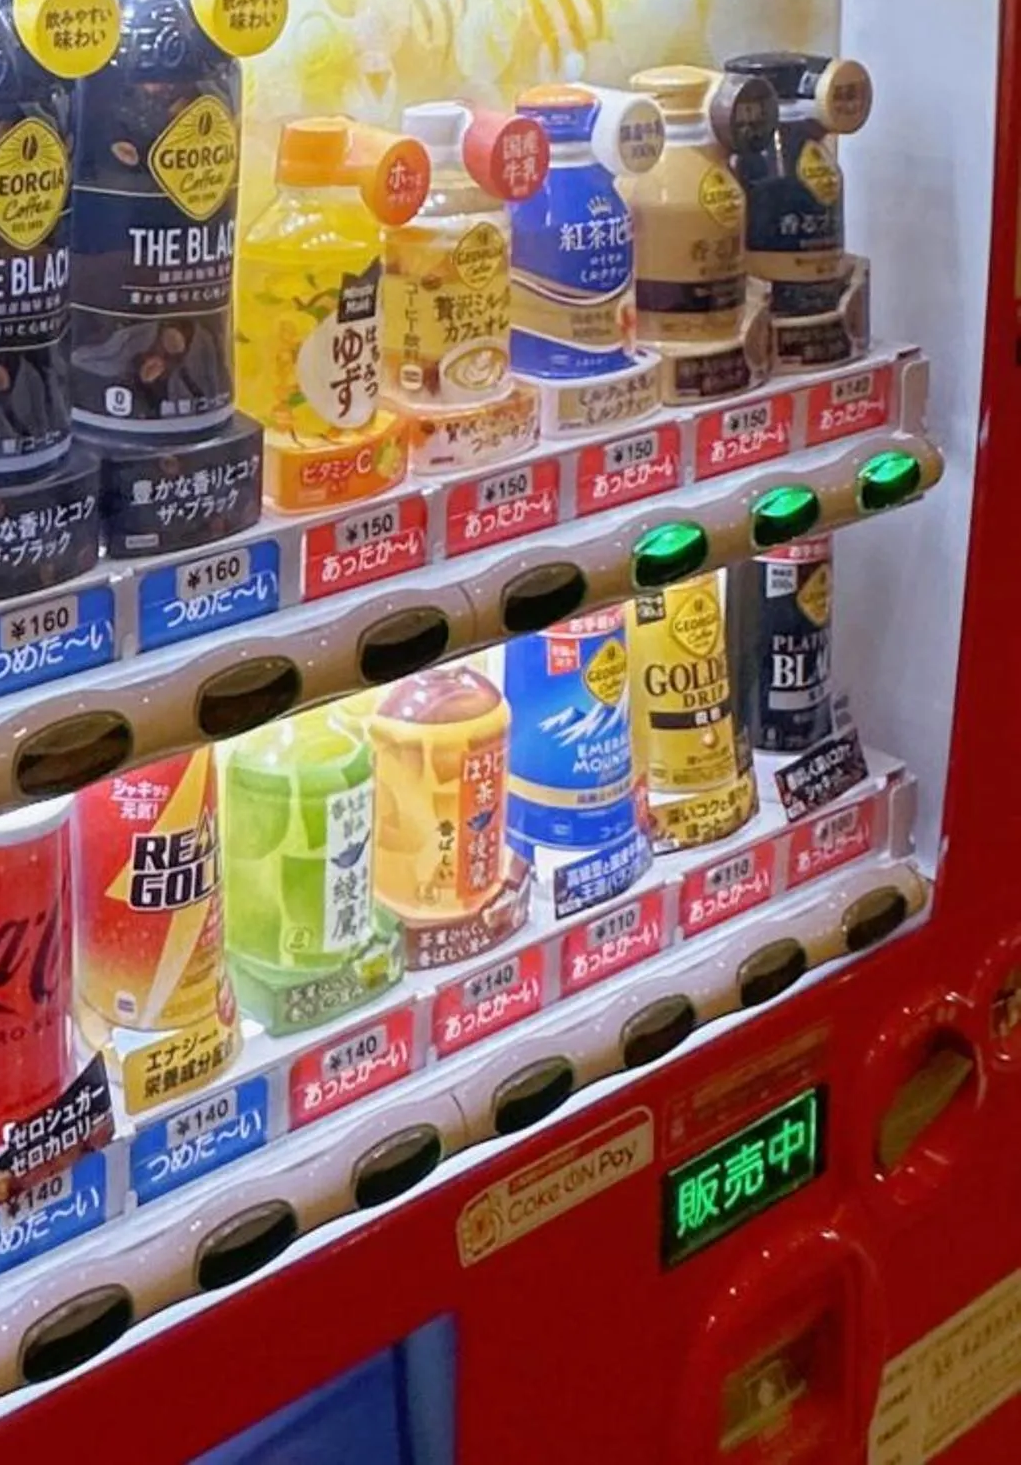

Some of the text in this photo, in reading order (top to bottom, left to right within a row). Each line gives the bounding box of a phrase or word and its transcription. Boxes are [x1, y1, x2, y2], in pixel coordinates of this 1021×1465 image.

[45, 7, 113, 28] 飲みやすい
[229, 9, 277, 32] 味わい
[53, 28, 106, 51] 味わい
[2, 194, 52, 221] Coffee
[128, 228, 183, 267] THE
[329, 326, 364, 420] ゆず
[729, 407, 767, 432] ¥150
[612, 437, 653, 463] ¥150
[131, 455, 260, 506] 豊かな香りとコク
[485, 473, 528, 502] ¥150
[156, 489, 239, 526] ザ・ブラック
[345, 513, 394, 543] ¥150
[186, 556, 241, 591] ¥160
[9, 606, 70, 641] ¥160
[595, 909, 636, 940] ¥110
[470, 964, 514, 997] ¥140
[329, 1034, 378, 1071] ¥140
[9, 1083, 106, 1151] ゼロシュガー
[176, 1098, 231, 1137] ¥140
[9, 1114, 106, 1180] ゼロカロリー
[508, 1182, 561, 1225] Coke
[598, 1138, 638, 1175] Pay
[676, 1118, 807, 1239] 販売中
[7, 1176, 64, 1218] ¥140
